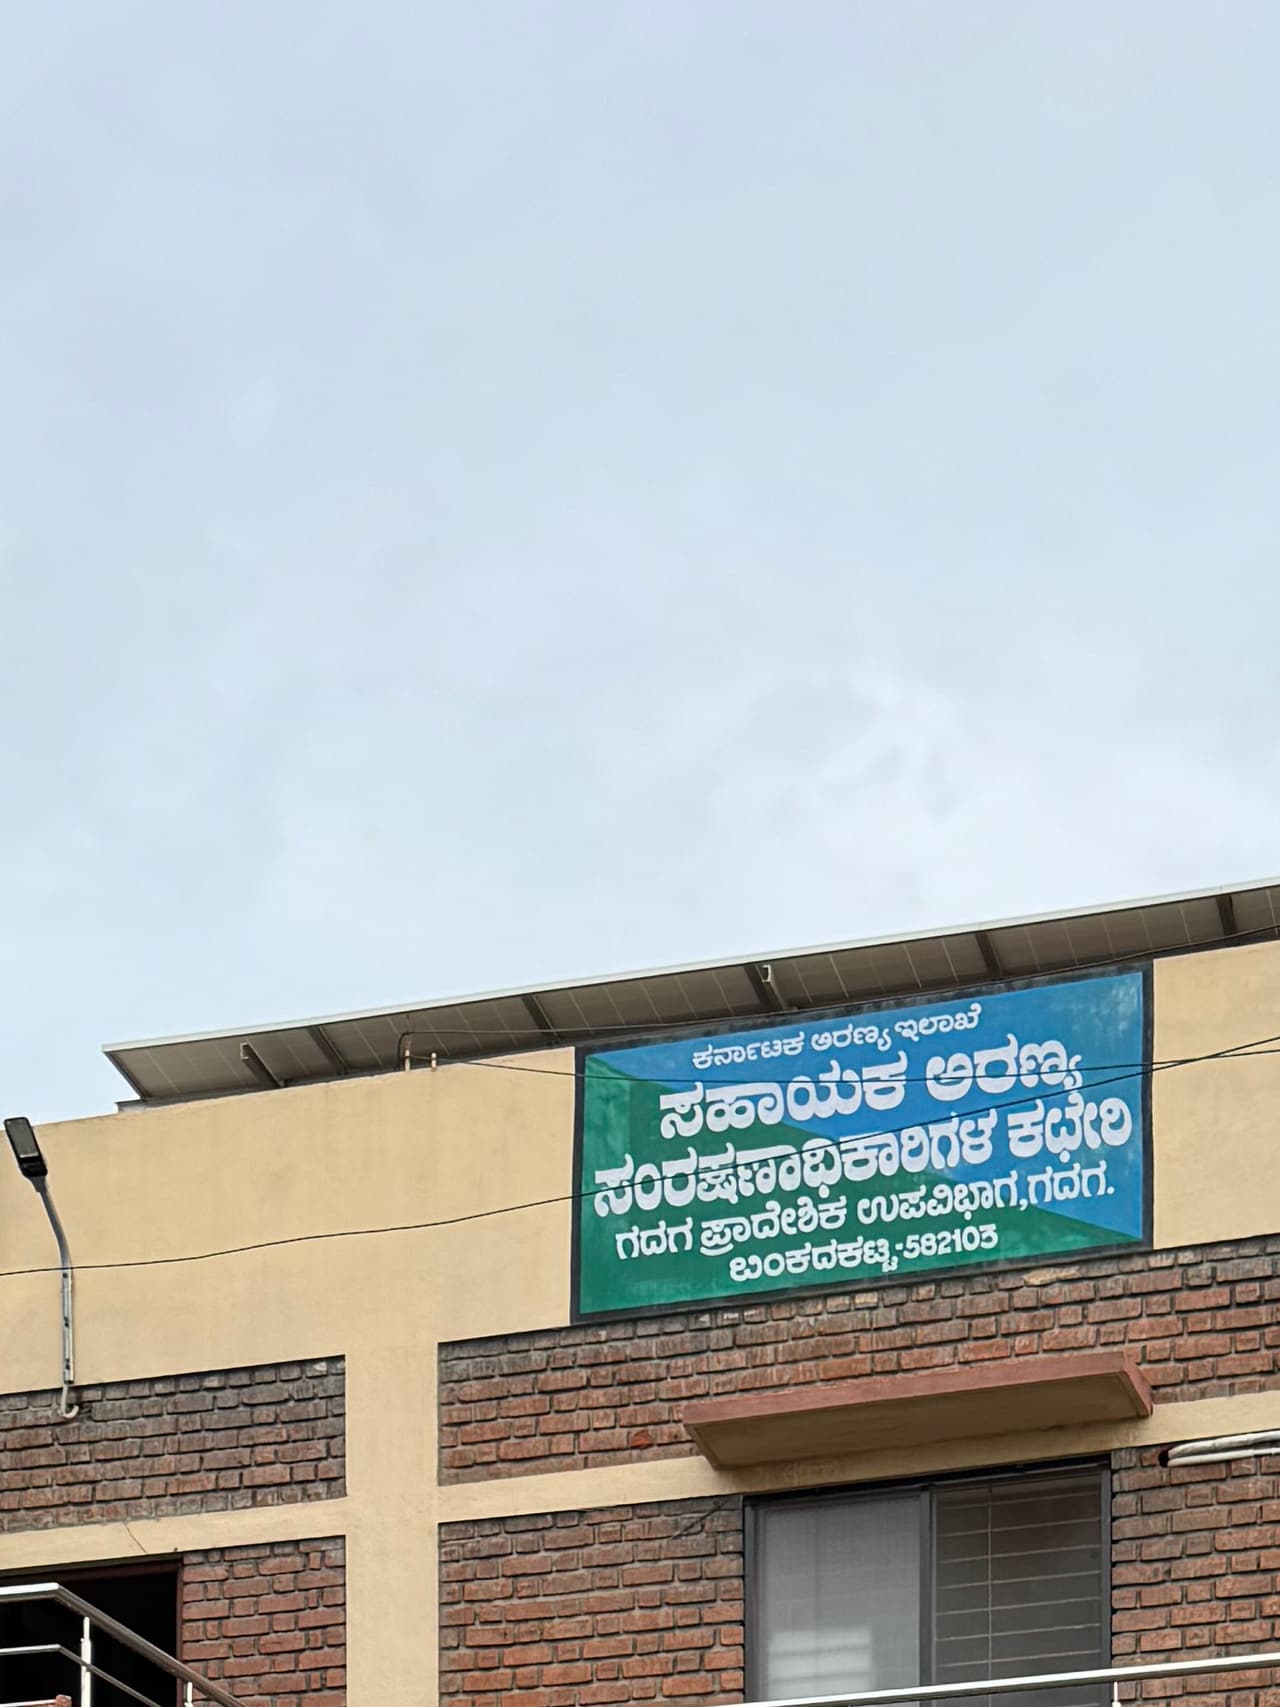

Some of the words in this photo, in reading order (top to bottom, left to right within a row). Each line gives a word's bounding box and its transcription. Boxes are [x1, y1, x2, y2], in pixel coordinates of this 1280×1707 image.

[811, 1022, 892, 1052] ಅರಣ್ಯ
[894, 1002, 982, 1042] ಇಲಾಖೆ
[659, 1049, 909, 1141] ಸಹಾಯಕ
[924, 1032, 1084, 1104] ಅರಣ್ಯ
[1007, 1088, 1133, 1164] ಕಛೇರಿ
[615, 1216, 694, 1260] ಗದಗ
[699, 1194, 848, 1257] ಪ್ರಾದೇಶಿಕ
